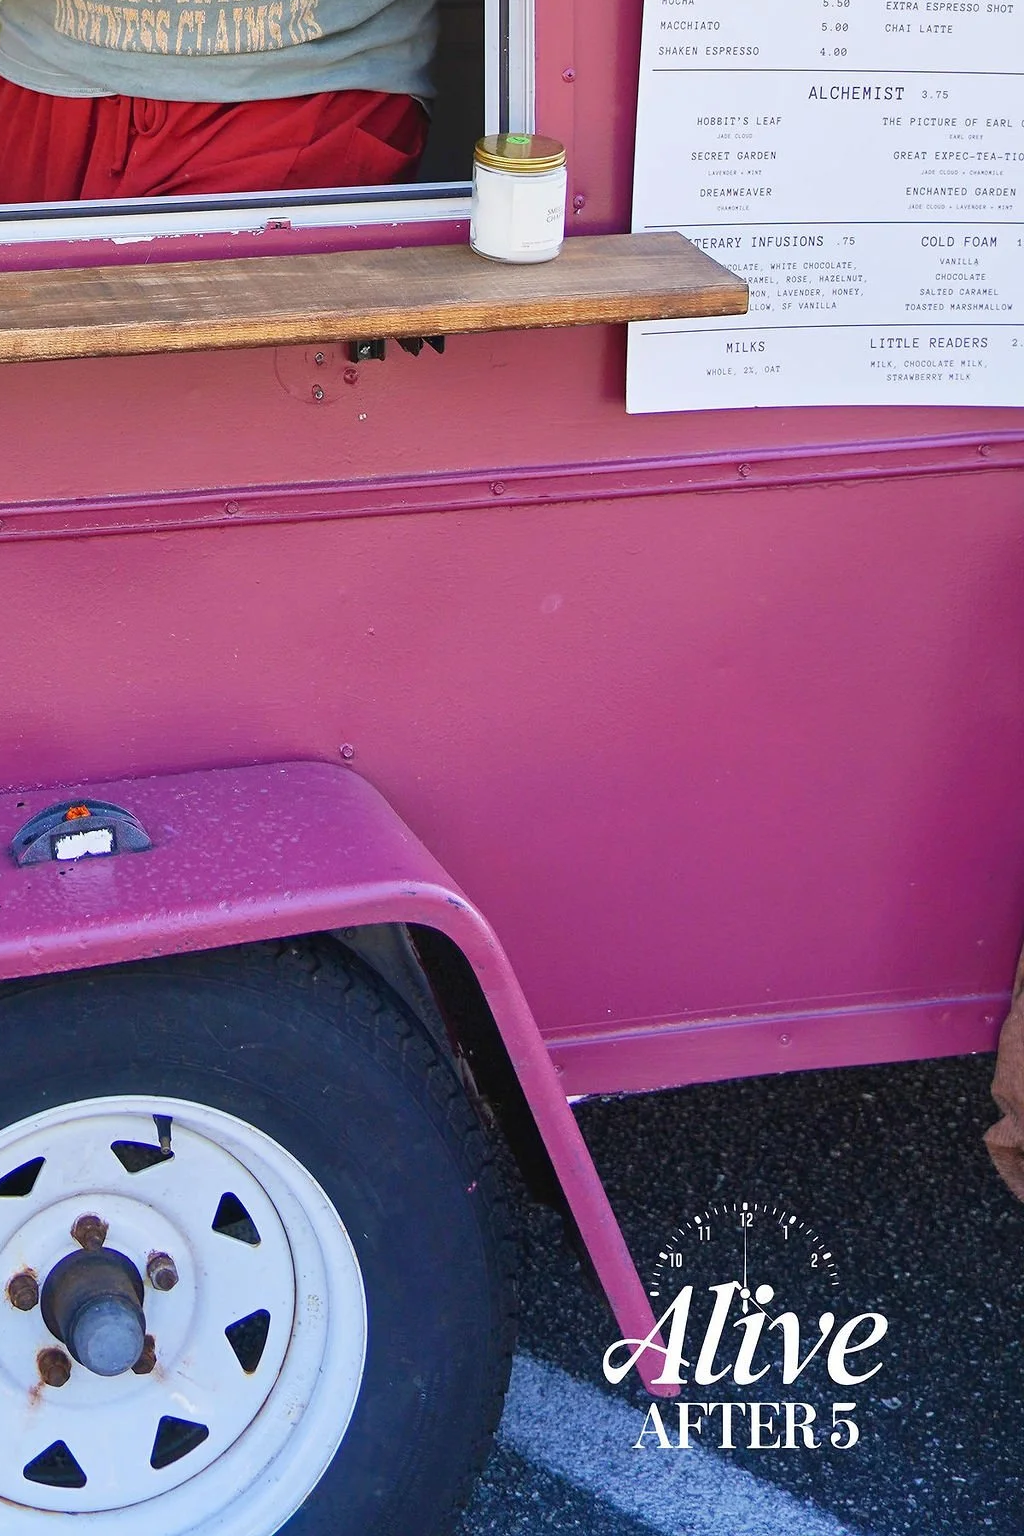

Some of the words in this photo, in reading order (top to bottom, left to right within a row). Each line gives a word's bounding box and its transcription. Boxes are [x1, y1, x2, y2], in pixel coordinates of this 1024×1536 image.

[886, 1, 919, 10] EXTRA
[926, 2, 980, 12] ESPRESSO
[986, 4, 1014, 14] SHOT
[175, 1, 283, 57] CLAIMS
[660, 20, 720, 30] MACCHIATO
[821, 22, 849, 32] 5.00
[884, 23, 911, 33] CHAI
[920, 24, 953, 34] LATTE
[658, 46, 698, 56] SHAKEN
[705, 46, 760, 56] ESPRESSO
[820, 47, 848, 57] 4.00
[808, 86, 904, 100] ALCHEMIST
[922, 90, 949, 100] 3.75
[697, 116, 749, 126] HOBBIT'S
[756, 116, 782, 126] LEAF
[882, 117, 902, 126] THE
[910, 117, 957, 127] PICTURE
[964, 118, 978, 127] OF
[986, 118, 1012, 128] EARL
[691, 151, 730, 161] SECRET
[736, 151, 776, 160] GARDEN
[893, 151, 927, 160] GREAT
[700, 187, 772, 198] DREAMWEAVER
[906, 186, 968, 196] ENCHANTED
[974, 187, 1016, 196] GARDEN
[752, 235, 824, 248] INFUSIONS
[921, 236, 955, 247] COLD
[964, 236, 997, 248] FOAM
[770, 262, 797, 270] WHITE
[939, 258, 979, 266] VANILLA
[935, 273, 986, 281] CHOCOLATE
[920, 288, 954, 296] SALTED
[959, 288, 998, 296] CARAMEL
[782, 302, 792, 310] SF
[798, 302, 837, 310] VANILLA
[905, 303, 944, 311] TOASTED
[950, 303, 1013, 311] MARSHMALLOW
[726, 341, 765, 353] MILKS
[870, 337, 920, 349] LITTLE
[929, 337, 988, 348] READERS
[904, 360, 954, 368] CHOCOLATE
[764, 365, 781, 374] OAT
[886, 373, 943, 382] STRAWBERRY
[948, 373, 970, 381] MILK
